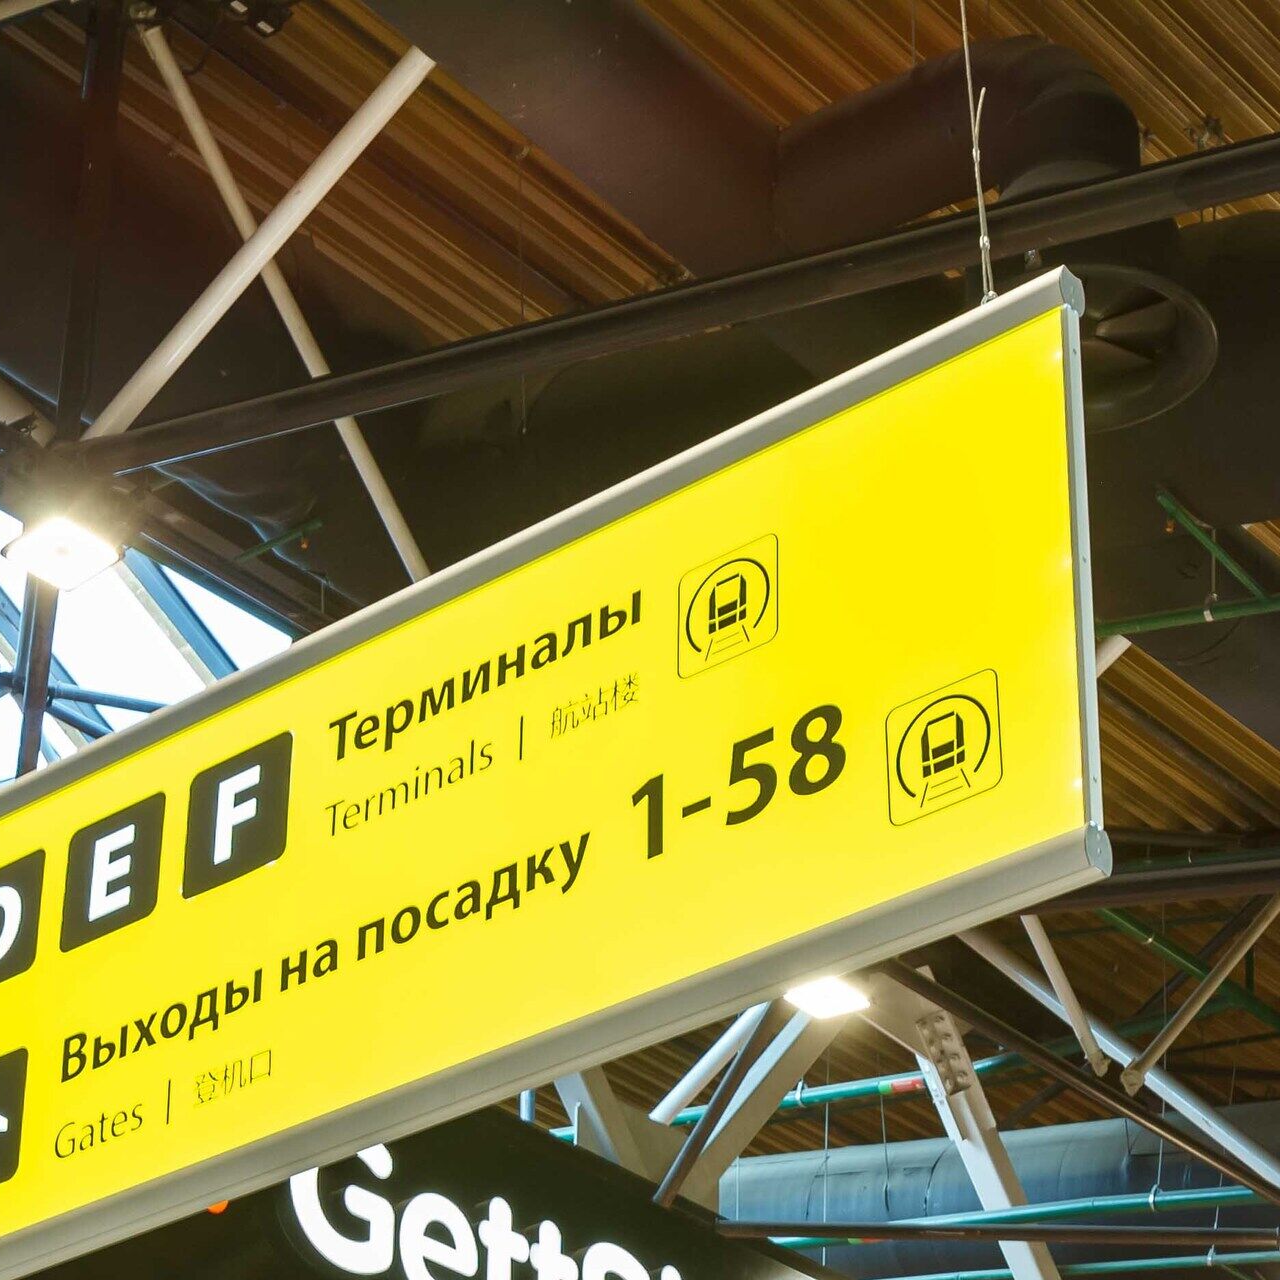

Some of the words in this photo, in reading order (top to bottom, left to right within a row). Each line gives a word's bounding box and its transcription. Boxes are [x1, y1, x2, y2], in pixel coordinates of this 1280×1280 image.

[328, 589, 642, 761] Терминалы
[551, 672, 639, 738] 航站楼
[325, 737, 494, 838] Terminals
[59, 966, 262, 1083] Выходы
[279, 936, 339, 993] на
[356, 830, 591, 962] посадку
[631, 704, 847, 860] 1-58
[88, 825, 135, 922] E
[213, 764, 261, 865] F
[192, 1049, 273, 1107] 登机口
[53, 1101, 144, 1160] Gates
